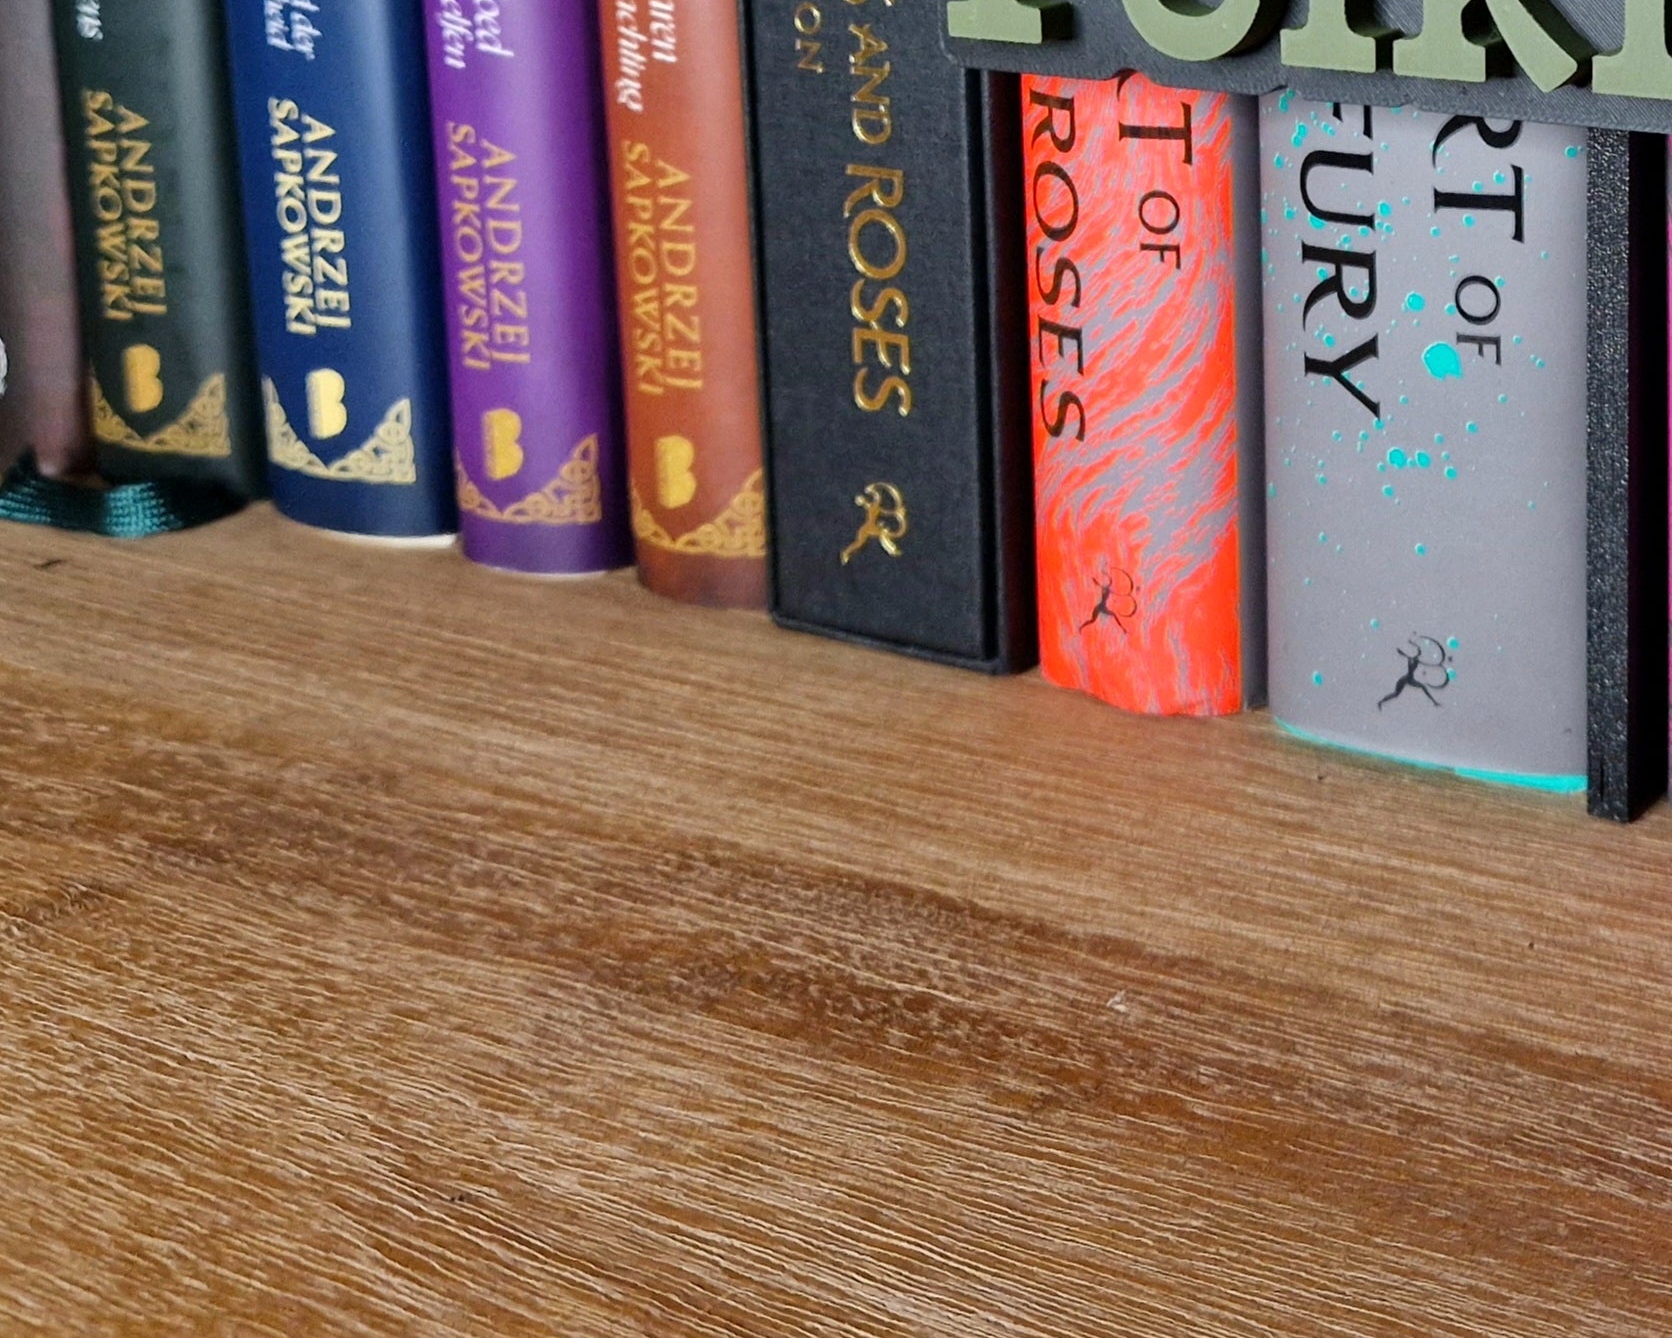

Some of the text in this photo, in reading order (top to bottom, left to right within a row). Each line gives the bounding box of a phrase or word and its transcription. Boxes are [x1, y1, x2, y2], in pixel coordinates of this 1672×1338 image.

[848, 23, 893, 146] AND
[82, 88, 133, 322] SAPKOWSKI
[112, 104, 167, 315] ANDRZEJ
[267, 96, 316, 335] SAPKOWSKI
[300, 113, 352, 329] ANDRZEJ
[446, 122, 491, 372] SAPKOWSKI
[479, 139, 531, 365] ANDRZEJ
[621, 139, 663, 397] SAPKOWSKI
[655, 159, 703, 390] ANDRZEJ
[846, 162, 911, 417] ROSES
[1028, 87, 1087, 442] ROSES
[1137, 190, 1181, 270] OF
[1454, 274, 1502, 366] OF
